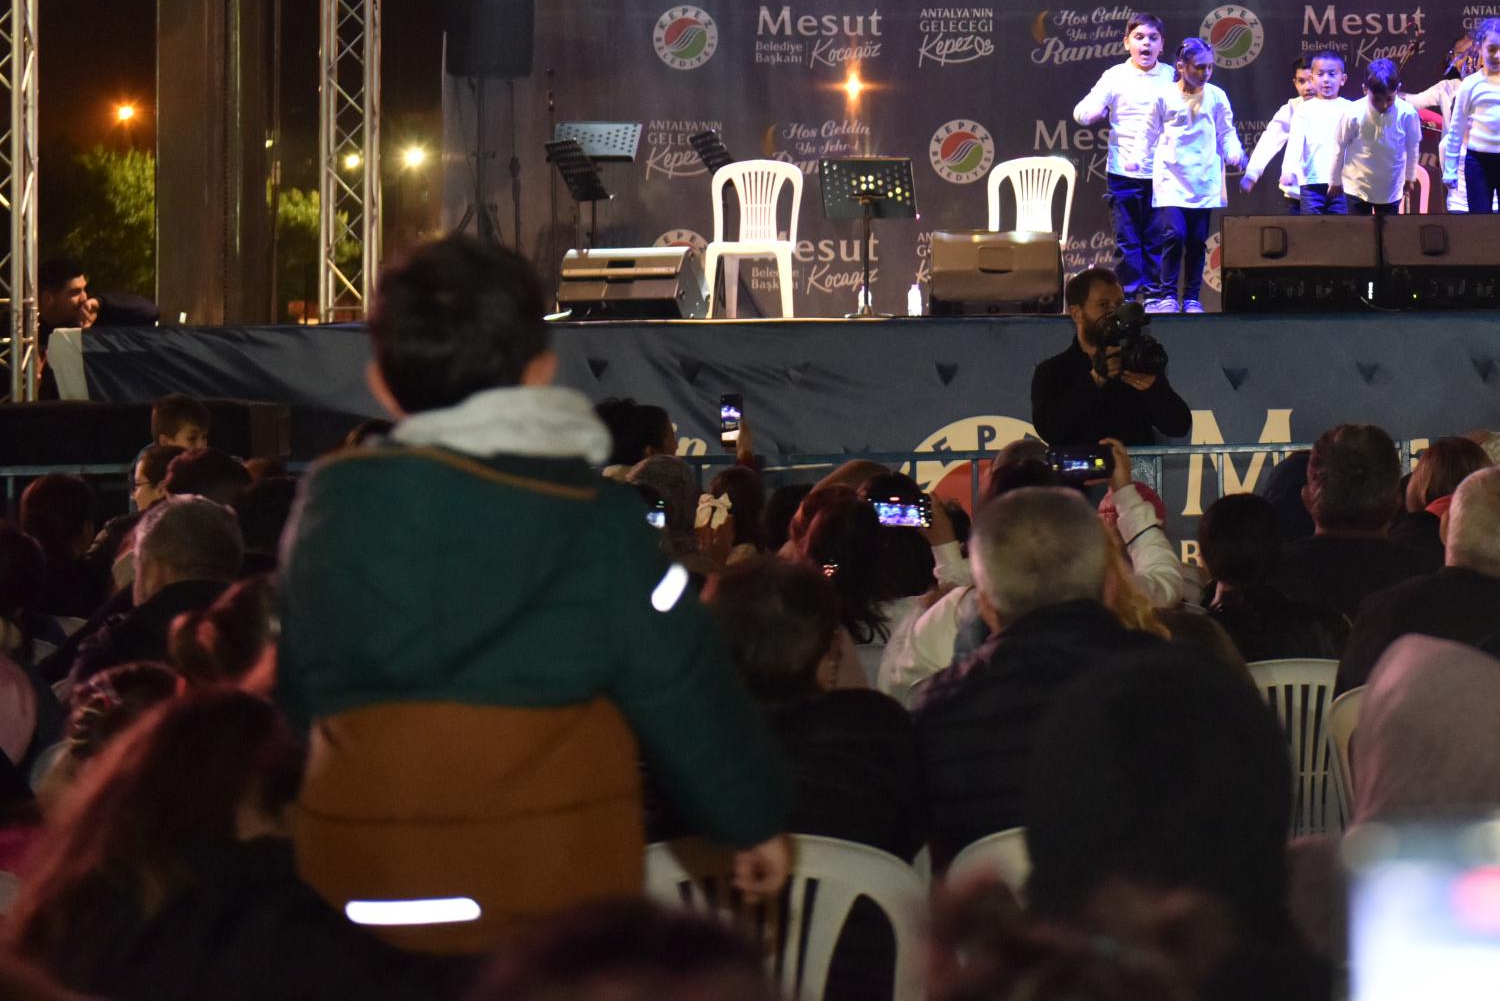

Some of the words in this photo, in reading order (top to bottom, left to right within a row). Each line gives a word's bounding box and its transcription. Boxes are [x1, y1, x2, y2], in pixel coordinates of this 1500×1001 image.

[658, 8, 712, 30] KEPEZ
[756, 6, 882, 36] Mesut
[920, 8, 993, 18] ANTALYA'NIN
[1203, 7, 1259, 30] KEPEZ
[1302, 5, 1426, 35] Mesut
[755, 41, 803, 54] Belediye
[810, 39, 882, 69] Kocagöz
[919, 33, 977, 67] Kepez
[1031, 37, 1131, 65] Ramaz
[934, 121, 989, 144] KEPEZ
[1033, 119, 1109, 150] Mes
[777, 231, 879, 262] esut
